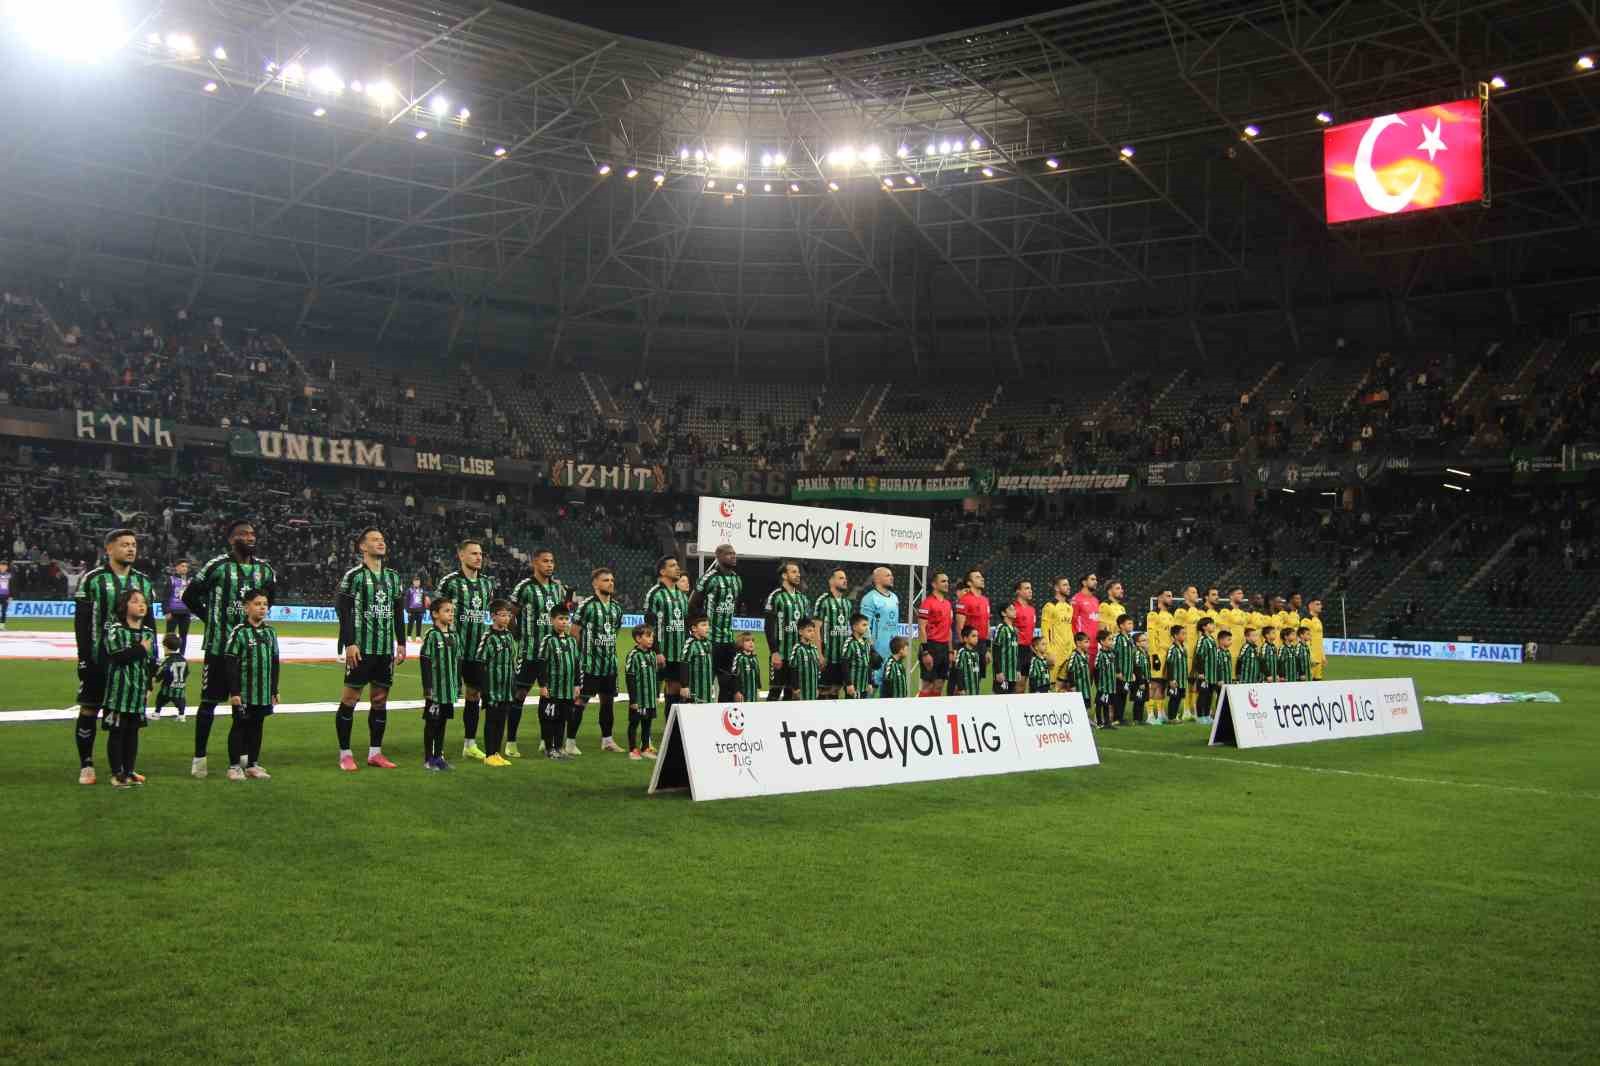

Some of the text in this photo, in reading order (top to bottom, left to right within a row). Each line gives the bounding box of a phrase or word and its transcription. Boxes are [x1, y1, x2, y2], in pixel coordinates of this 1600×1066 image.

[416, 452, 441, 471] HM
[747, 512, 839, 549] trendyol
[1332, 641, 1431, 657] FANATIC TOUR
[1472, 646, 1519, 660] FANAT
[1024, 709, 1074, 727] trendyol
[1274, 695, 1347, 731] trendyol
[714, 738, 764, 754] trendyol
[779, 715, 943, 767] trendyol
[1035, 730, 1073, 748] yemek
